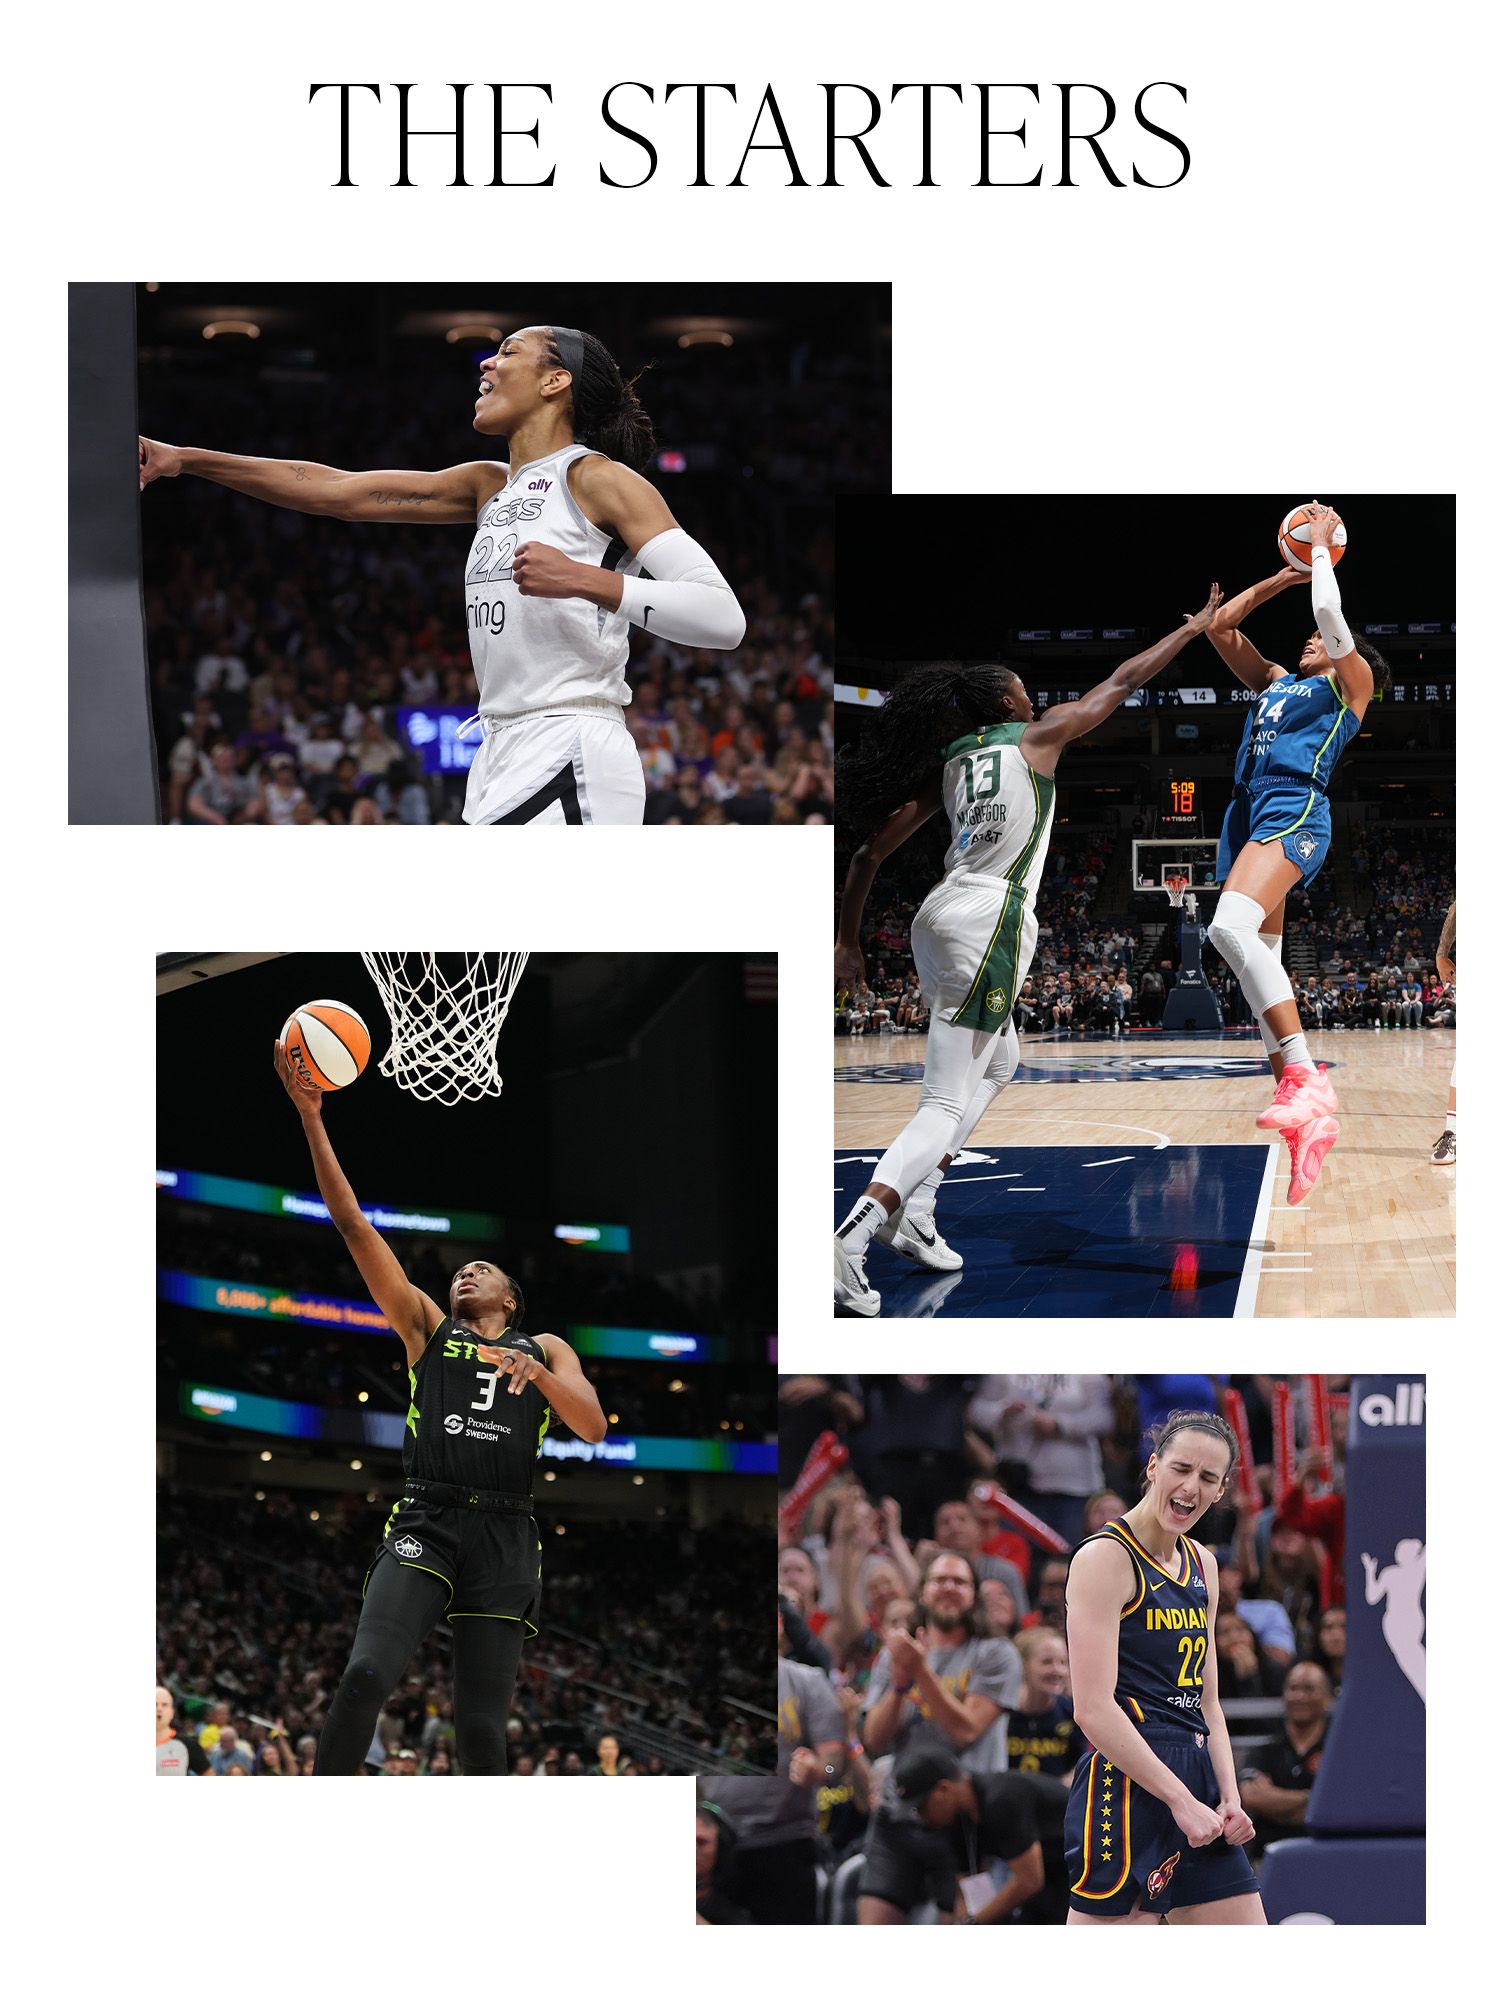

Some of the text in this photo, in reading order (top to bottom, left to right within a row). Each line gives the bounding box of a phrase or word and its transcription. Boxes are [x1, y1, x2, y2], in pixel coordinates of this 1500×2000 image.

[528, 479, 553, 493] ally
[466, 533, 518, 586] 22
[466, 596, 506, 636] ring
[1192, 691, 1207, 702] 14
[1231, 690, 1257, 701] 5:09
[1253, 697, 1287, 727] 24
[960, 750, 1002, 804] 13
[1171, 782, 1195, 794] 5:09
[1174, 793, 1193, 814] 18
[471, 1371, 498, 1411] 3
[1359, 1382, 1426, 1428] all
[465, 1429, 499, 1442] SWEDISH
[467, 1417, 511, 1434] Providence
[542, 1437, 595, 1462] Equity
[1146, 1607, 1208, 1631] INDIAN
[1177, 1635, 1207, 1687] 22
